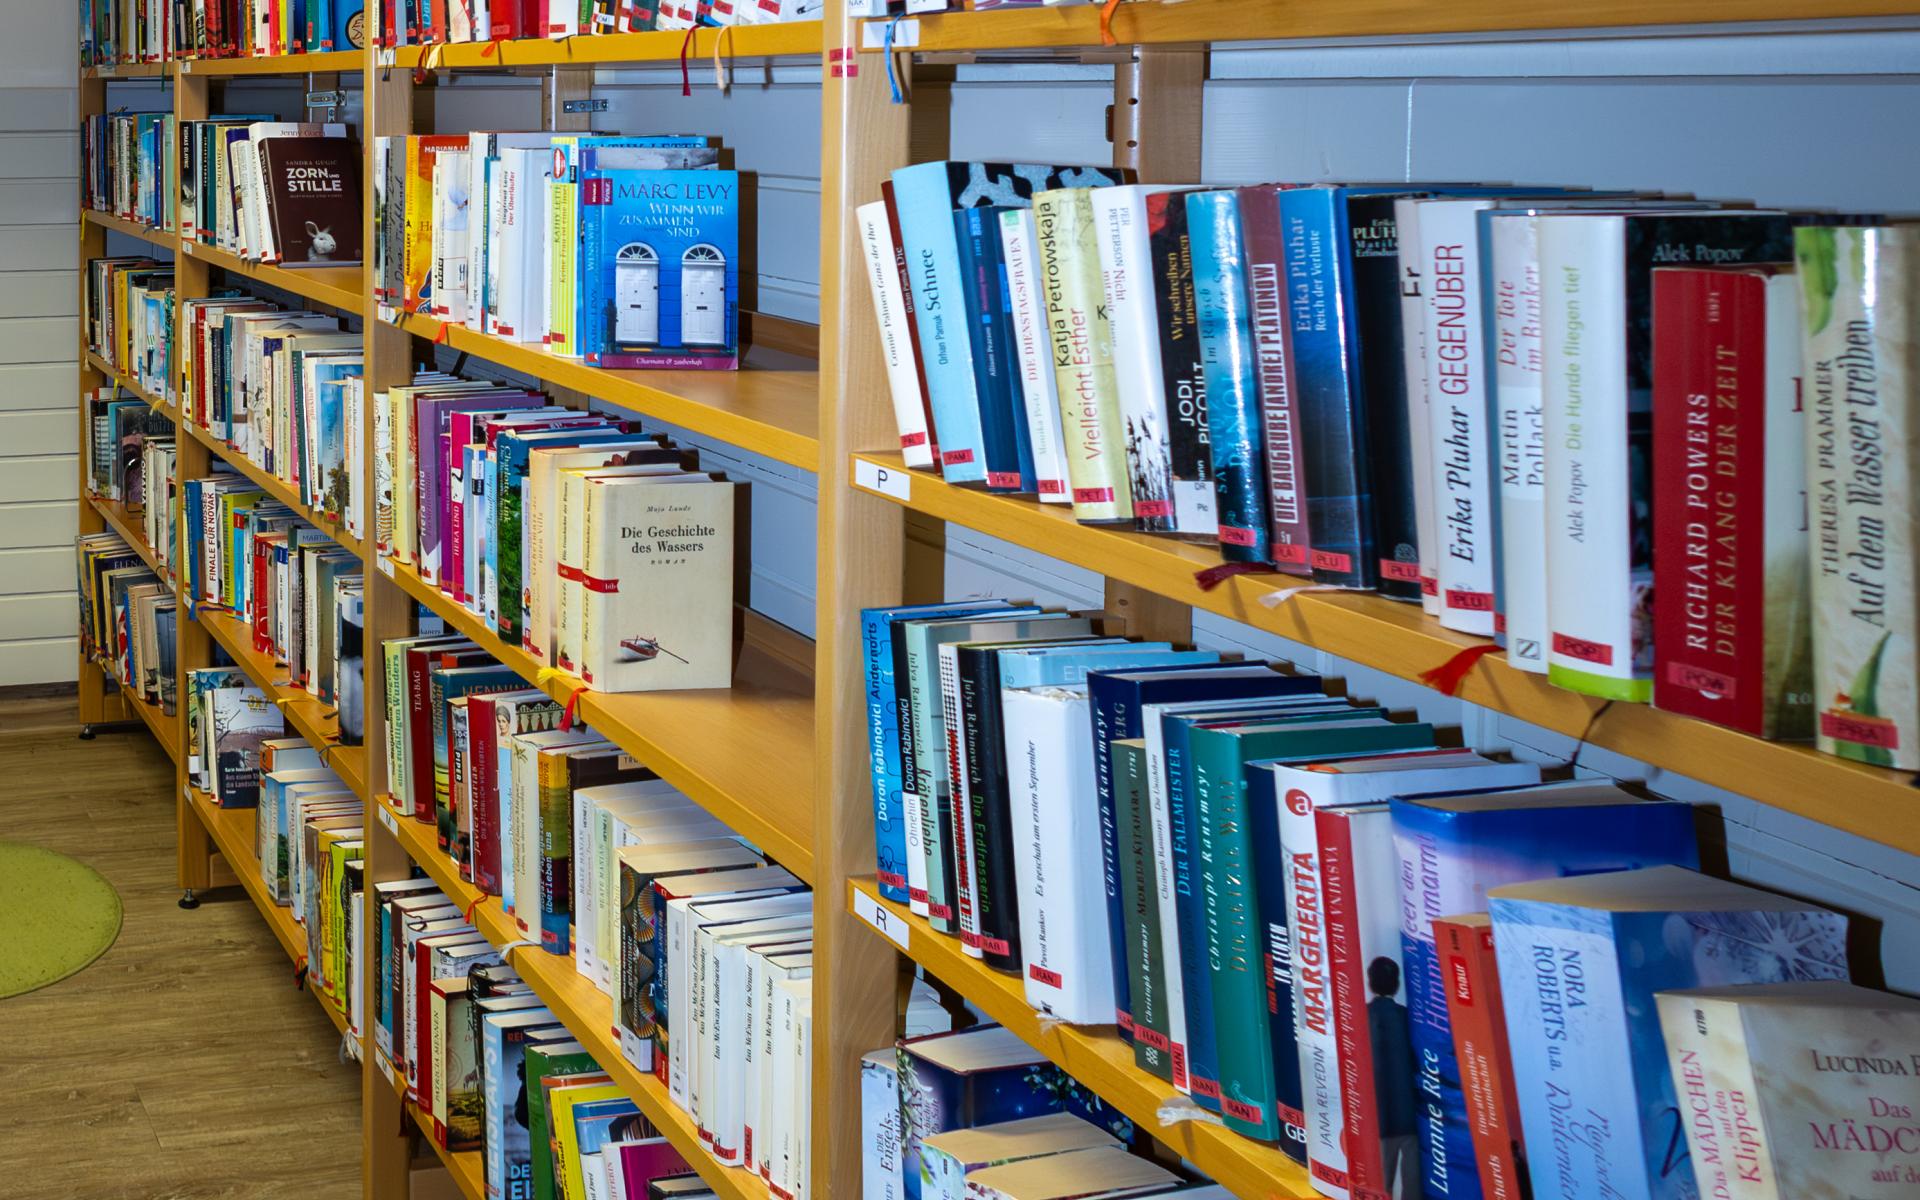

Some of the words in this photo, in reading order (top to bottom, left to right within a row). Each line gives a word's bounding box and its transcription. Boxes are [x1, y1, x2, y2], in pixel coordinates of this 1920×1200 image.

[286, 168, 328, 179] ZORN
[288, 180, 342, 192] STILLE
[618, 184, 677, 199] MARC
[685, 184, 732, 200] LEVY
[586, 222, 594, 242] WIR
[618, 215, 695, 226] ZUSAMMEN
[650, 202, 694, 214] WENN
[697, 205, 725, 216] WIR
[666, 227, 701, 238] SIND
[586, 243, 595, 271] WENN
[1039, 201, 1065, 315] Petrowskaja
[1108, 208, 1125, 270] PETTERSON
[1288, 216, 1306, 280] Pluhar
[1308, 229, 1323, 277] Verluste
[921, 248, 942, 312] Schnee
[1009, 236, 1036, 356] DIENSTAGSFRAUEN
[1113, 268, 1126, 302] Nicht
[1167, 252, 1183, 313] schreiben
[1312, 278, 1325, 299] der
[1494, 280, 1515, 321] Tote
[1519, 266, 1542, 340] Bunker
[1562, 264, 1581, 294] tief
[932, 314, 946, 341] Pamuk
[1171, 314, 1184, 341] Wir
[1253, 264, 1280, 345] PLATONOW
[1295, 282, 1311, 334] Erika
[1313, 300, 1327, 333] Reich
[1430, 243, 1470, 397] GEGENÜBER
[1562, 300, 1585, 357] fliegen
[934, 341, 949, 366] Orhan
[1055, 318, 1072, 367] Katja
[1070, 307, 1090, 365] Esther
[1497, 325, 1518, 368] Der
[1521, 345, 1542, 374] im
[1026, 357, 1038, 382] DIE
[1261, 343, 1288, 406] ANDREJ
[1717, 344, 1737, 411] ZEIT
[1835, 318, 1878, 409] treiben
[1177, 379, 1195, 428] JODI
[1564, 362, 1583, 417] Hunde
[1075, 371, 1102, 461] Vielleicht
[1565, 423, 1582, 451] Die
[1815, 360, 1836, 471] PRAMMER
[503, 445, 512, 496] Charlotte
[1266, 411, 1294, 491] BAUGRUBE
[1443, 406, 1475, 489] Pluhar
[1502, 408, 1520, 487] Martin
[1525, 404, 1545, 487] Pollack
[1686, 392, 1710, 510] POWERS
[1715, 416, 1737, 479] DER
[1845, 411, 1885, 509] Wasser
[418, 470, 426, 499] Lind
[878, 469, 889, 489] P
[1567, 459, 1588, 506] Popov
[207, 492, 215, 524] NOVAK
[419, 505, 427, 537] Hera
[452, 505, 460, 528] LIND
[503, 497, 512, 525] Link
[621, 526, 643, 539] Die
[648, 524, 716, 538] Geschichte
[646, 504, 665, 513] Maja
[669, 504, 691, 512] Lunde
[1276, 495, 1297, 522] DIE
[1446, 497, 1475, 566] Erika
[1568, 509, 1586, 544] Alek
[1818, 478, 1840, 577] THERESA
[208, 525, 216, 546] FÜR
[453, 530, 461, 557] HERA
[632, 541, 652, 554] des
[657, 540, 705, 554] Wassers
[1715, 491, 1737, 590] KLANG
[1847, 513, 1886, 571] dem
[1687, 522, 1710, 651] RICHARD
[1846, 573, 1886, 629] Auf
[1715, 603, 1737, 657] DER
[392, 654, 401, 707] Wunders
[866, 621, 882, 700] Andernorts
[961, 677, 976, 710] Julya
[871, 702, 886, 775] Rabinovici
[899, 697, 912, 756] Rabinovici
[964, 713, 982, 785] Rabinowich
[902, 758, 916, 792] Doron
[1094, 707, 1110, 799] Ransmayr
[873, 778, 889, 822] Doron
[908, 798, 919, 849] Ohnehin
[971, 795, 985, 818] Die
[1168, 747, 1189, 854] FALLMEISTER
[1197, 763, 1214, 864] Ransmayr
[975, 821, 992, 914] Erdfresserin
[1100, 805, 1116, 898] Christoph
[1400, 858, 1416, 889] den
[544, 856, 553, 913] überleben
[1176, 860, 1192, 898] DER
[1325, 846, 1343, 916] YASMINA
[1418, 835, 1443, 927] umarmt
[876, 906, 888, 930] R
[1203, 870, 1222, 972] Christoph
[1401, 897, 1420, 959] Meer
[1293, 853, 1328, 1035] MARGHERITA
[1330, 922, 1347, 965] REZA
[712, 954, 720, 1006] Kindeswohl
[766, 976, 774, 997] Solar
[1409, 963, 1422, 993] das
[1421, 932, 1450, 1033] Himmel
[1456, 963, 1470, 1000] Knaur
[1532, 944, 1568, 1043] ROBERTS
[1560, 947, 1587, 1009] NORA
[713, 1007, 721, 1043] McEwan
[765, 1002, 773, 1039] McEwan
[1335, 969, 1354, 1038] Glücklich
[1411, 997, 1425, 1025] Wo
[433, 1009, 441, 1054] MENNEN
[713, 1044, 721, 1060] Ian
[745, 1012, 753, 1048] McEwan
[1344, 1039, 1356, 1060] die
[433, 1056, 441, 1102] PATRICIA
[745, 1049, 753, 1063] Ian
[1314, 1047, 1329, 1102] REVEDIN
[1421, 1048, 1442, 1100] Rice
[1548, 1045, 1563, 1072] u.a.
[1810, 1048, 1908, 1076] LUCINDA
[1342, 1061, 1361, 1136] Glücklichen
[1476, 1054, 1499, 1129] Freundschaft
[1679, 1048, 1723, 1166] MÄDCHEN
[1867, 1097, 1912, 1119] Das
[877, 1111, 896, 1173] Engels-
[1319, 1103, 1335, 1149] JANA
[1427, 1102, 1450, 1195] Luanne
[1729, 1089, 1763, 1184] Klippen
[1713, 1167, 1731, 1200] Das
[1871, 1168, 1900, 1184] auf
